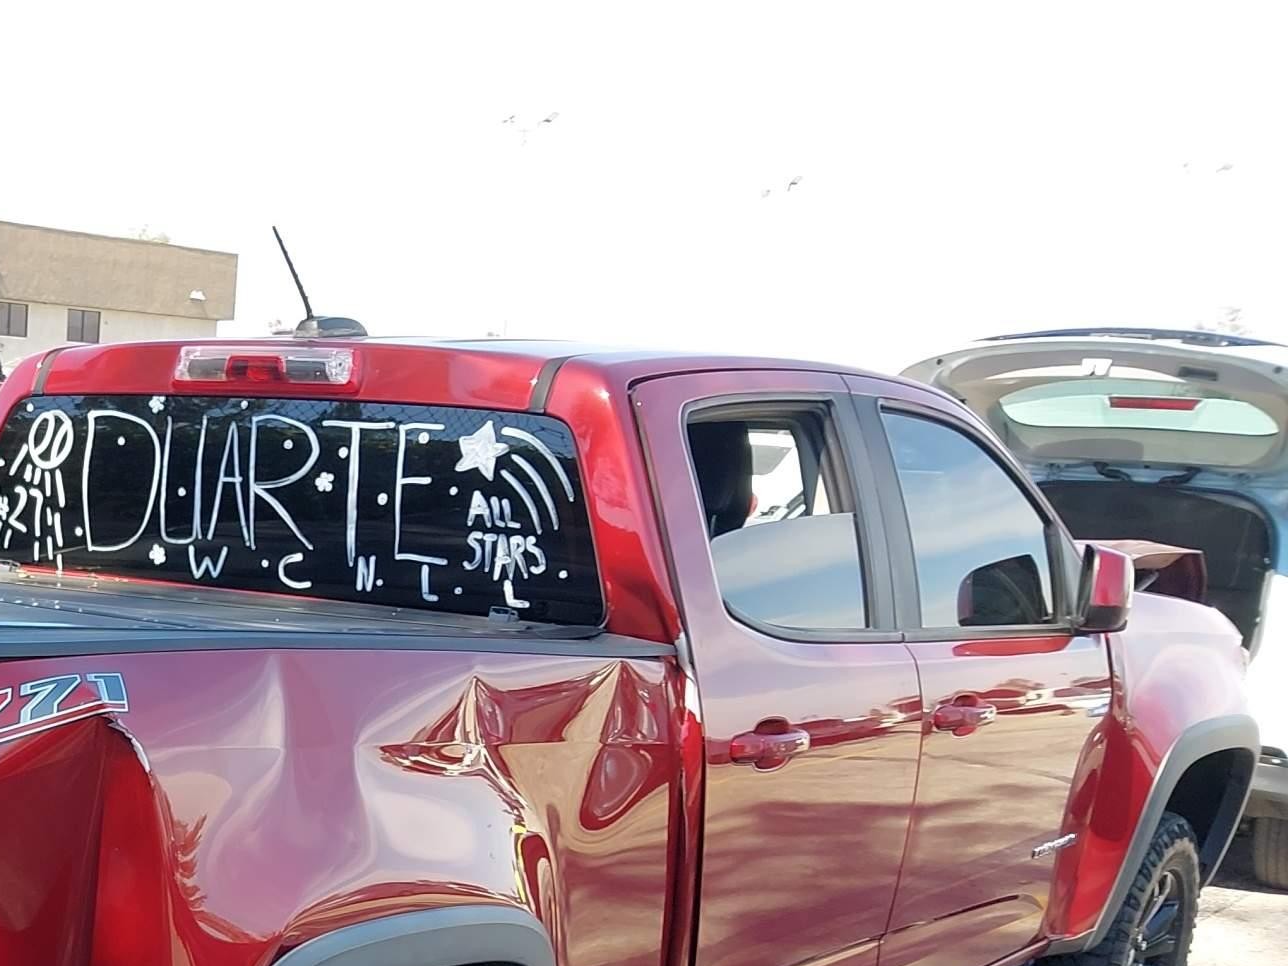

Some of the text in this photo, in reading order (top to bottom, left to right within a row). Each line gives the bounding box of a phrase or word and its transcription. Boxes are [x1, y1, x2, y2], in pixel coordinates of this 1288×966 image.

[82, 410, 448, 567] DUARTE
[467, 490, 521, 529] ALL
[462, 531, 546, 581] STARS
